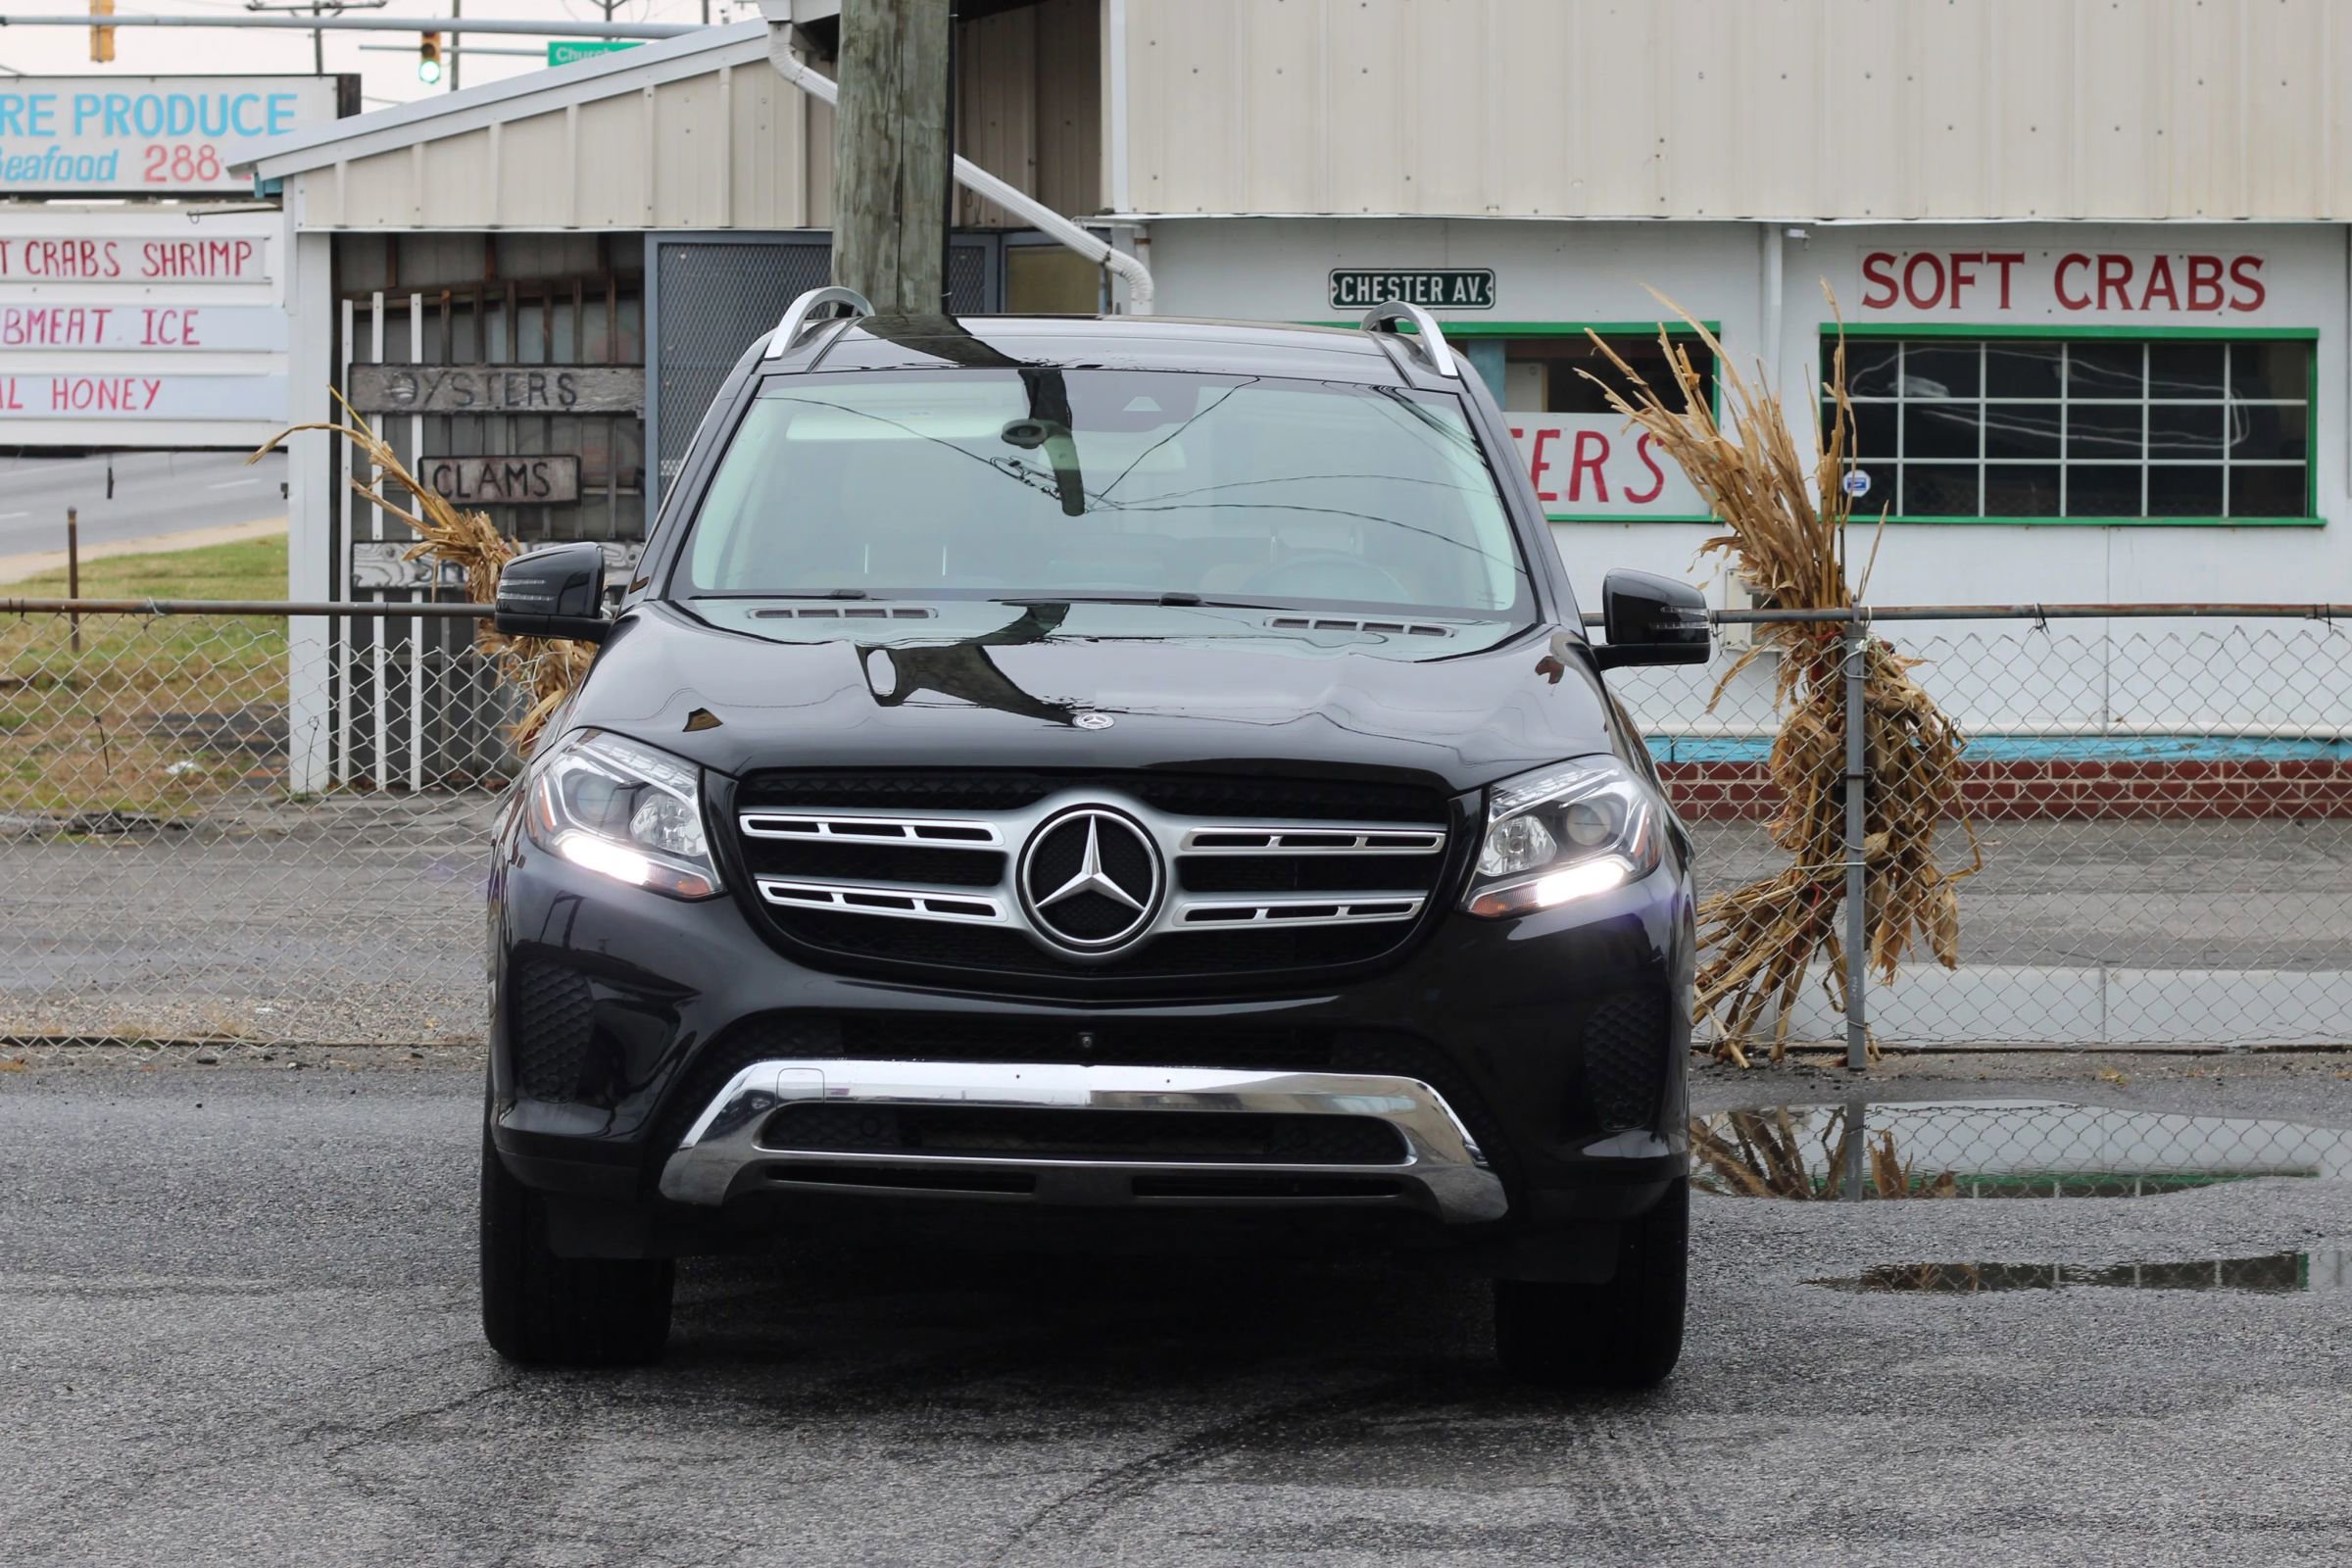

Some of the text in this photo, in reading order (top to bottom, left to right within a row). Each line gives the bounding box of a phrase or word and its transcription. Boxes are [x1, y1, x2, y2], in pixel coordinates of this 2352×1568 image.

[0, 93, 298, 136] RE PRODUCE
[0, 144, 220, 183] eafood 288
[24, 240, 121, 277] CRABS
[141, 240, 253, 277] SHRIMP
[1341, 276, 1484, 303] CHESTER AV.
[1862, 251, 2267, 312] SOFT CRABS
[3, 309, 201, 345] BMEAT ICE
[0, 377, 162, 411] L HONEY
[392, 370, 578, 408] OYSTERS
[433, 462, 552, 498] CLAMS
[1510, 428, 1665, 504] ERS
